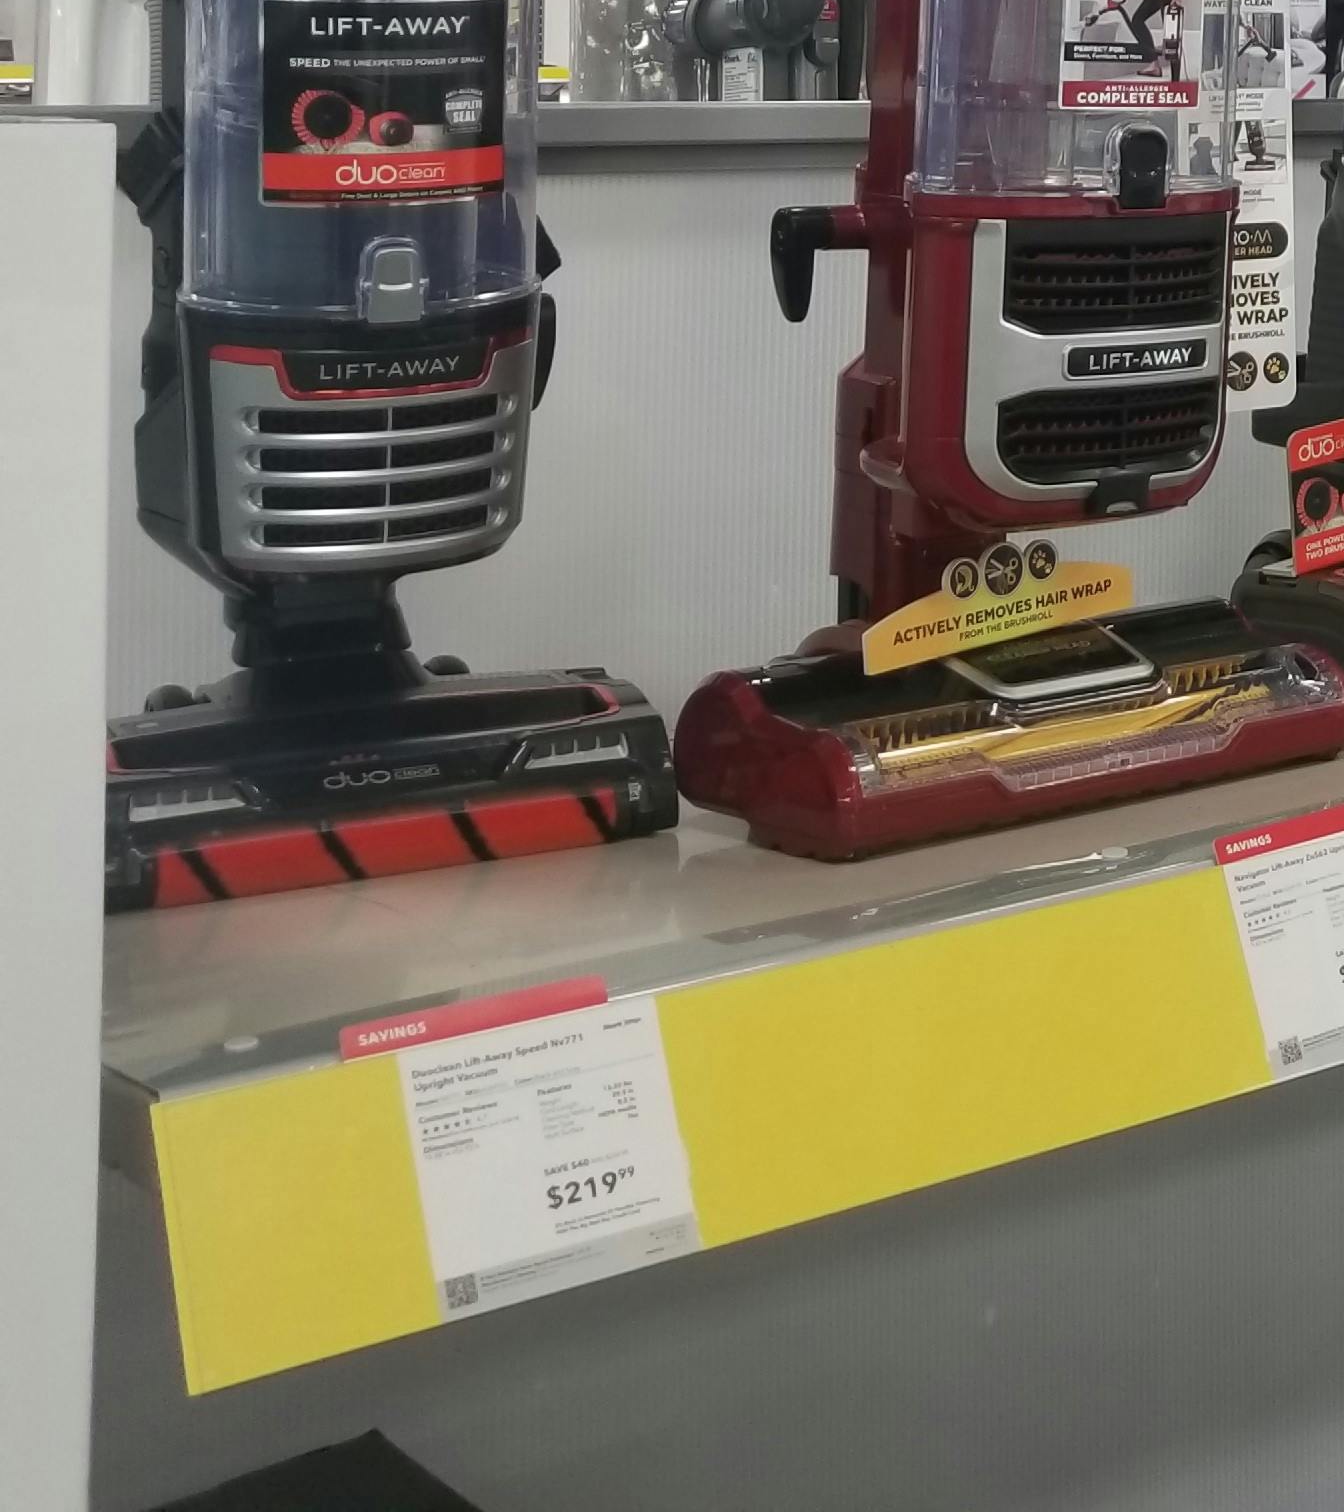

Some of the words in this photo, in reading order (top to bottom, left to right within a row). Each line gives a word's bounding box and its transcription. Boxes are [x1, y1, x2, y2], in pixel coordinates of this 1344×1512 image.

[1244, 0, 1273, 7] CLEAN
[311, 16, 468, 37] LIFT-AWAY
[1077, 92, 1156, 105] COMPLETE
[1158, 92, 1189, 104] SEAL
[1248, 246, 1273, 256] HEAD
[1237, 308, 1289, 326] WRAP
[1238, 329, 1285, 340] BRUSHROLL
[319, 355, 460, 381] LIFT-AWAY
[1088, 345, 1193, 372] LIFT-AWAY
[1306, 550, 1324, 560] TWO
[892, 615, 962, 646] ACTIVELY
[965, 598, 1032, 627] REMOVES
[1035, 589, 1068, 607] HAIR
[1070, 578, 1112, 600] WRAP
[959, 627, 984, 641] FROM
[986, 624, 1002, 634] THE
[1003, 611, 1053, 630] BRUSHROLL
[1225, 833, 1272, 854] SAVINGS
[357, 1021, 427, 1047] SAVINGS
[411, 1061, 462, 1080] Duoclean
[515, 1040, 548, 1060] Speed
[413, 1071, 455, 1094] Upright
[457, 1066, 499, 1083] Vacuum
[418, 1108, 461, 1125] Customer
[462, 1101, 498, 1115] Reviews
